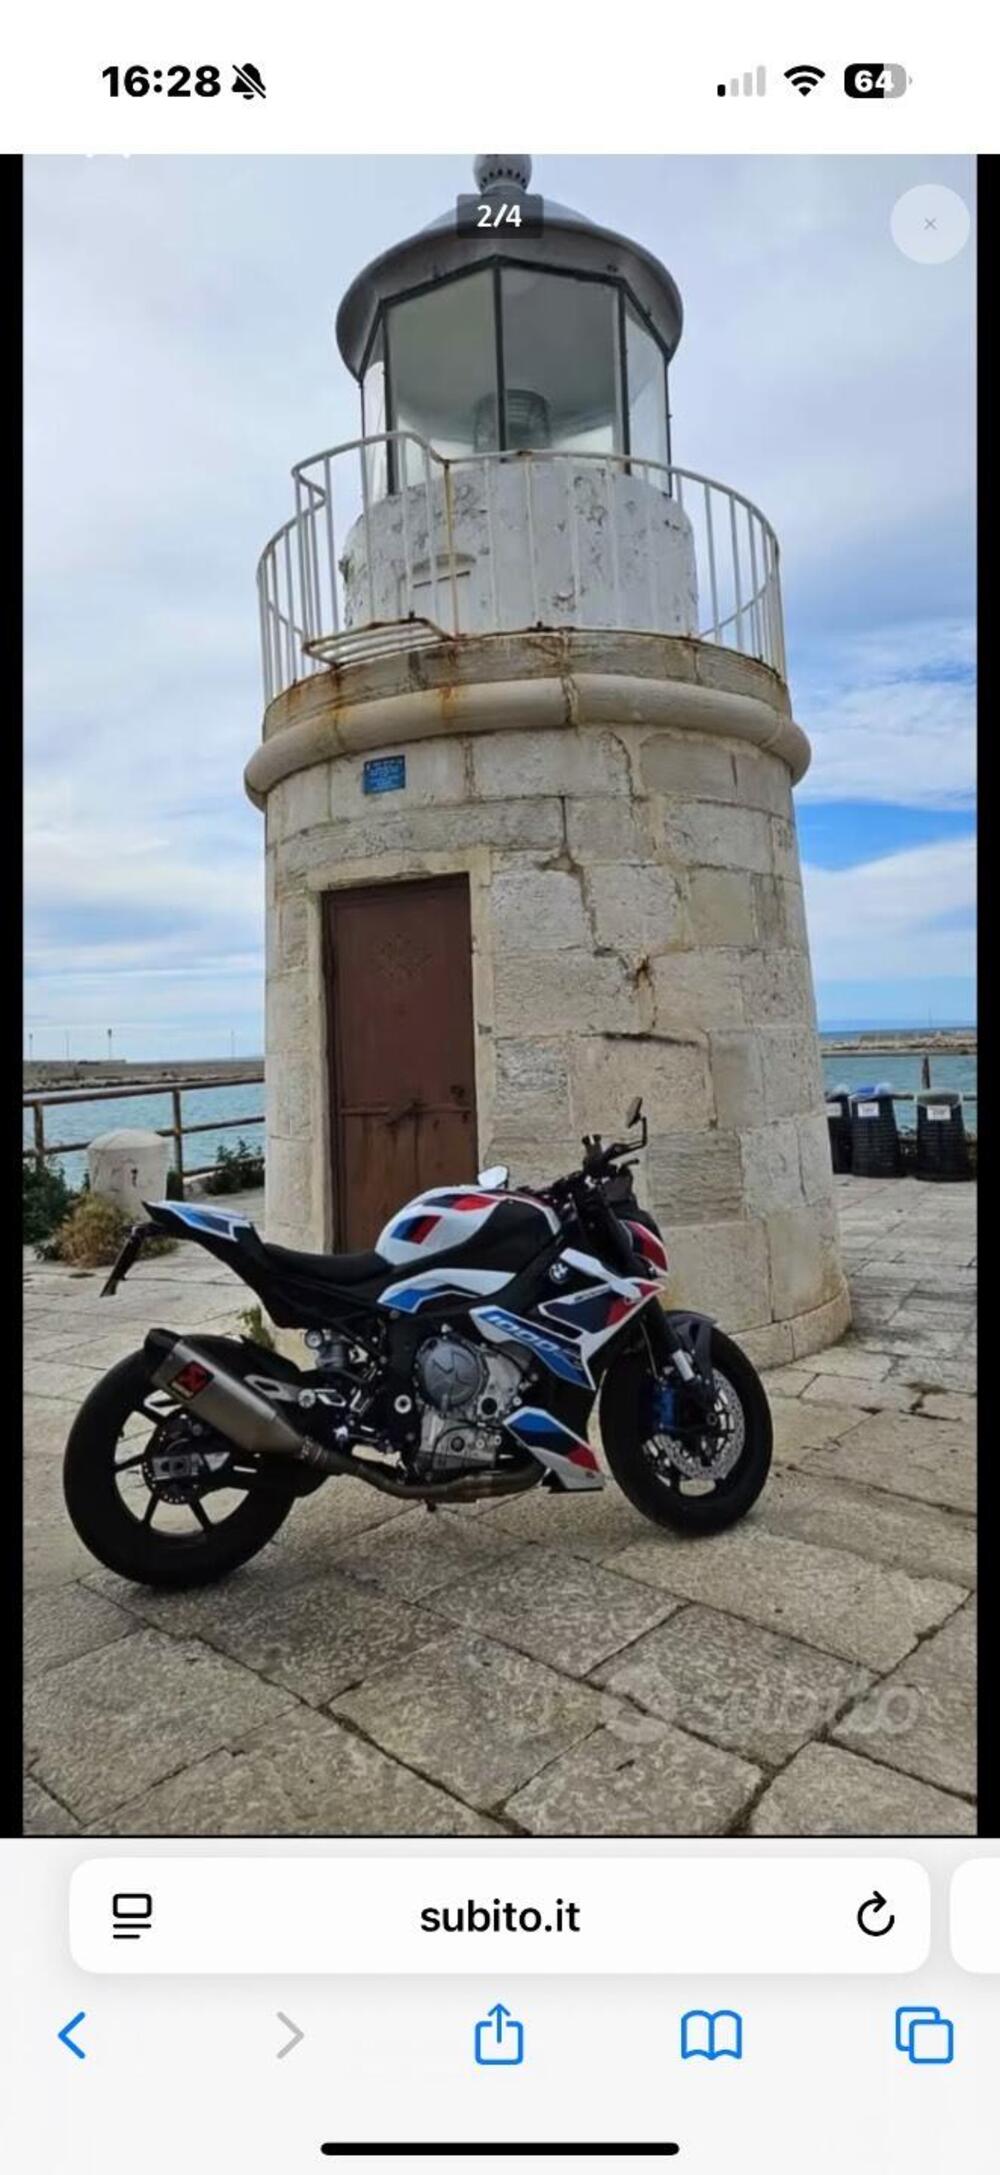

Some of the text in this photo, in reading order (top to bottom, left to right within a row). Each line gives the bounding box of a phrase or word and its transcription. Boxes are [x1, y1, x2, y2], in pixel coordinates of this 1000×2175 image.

[102, 64, 221, 98] 16:28
[854, 69, 895, 93] 64
[420, 1898, 581, 1933] subito.it
